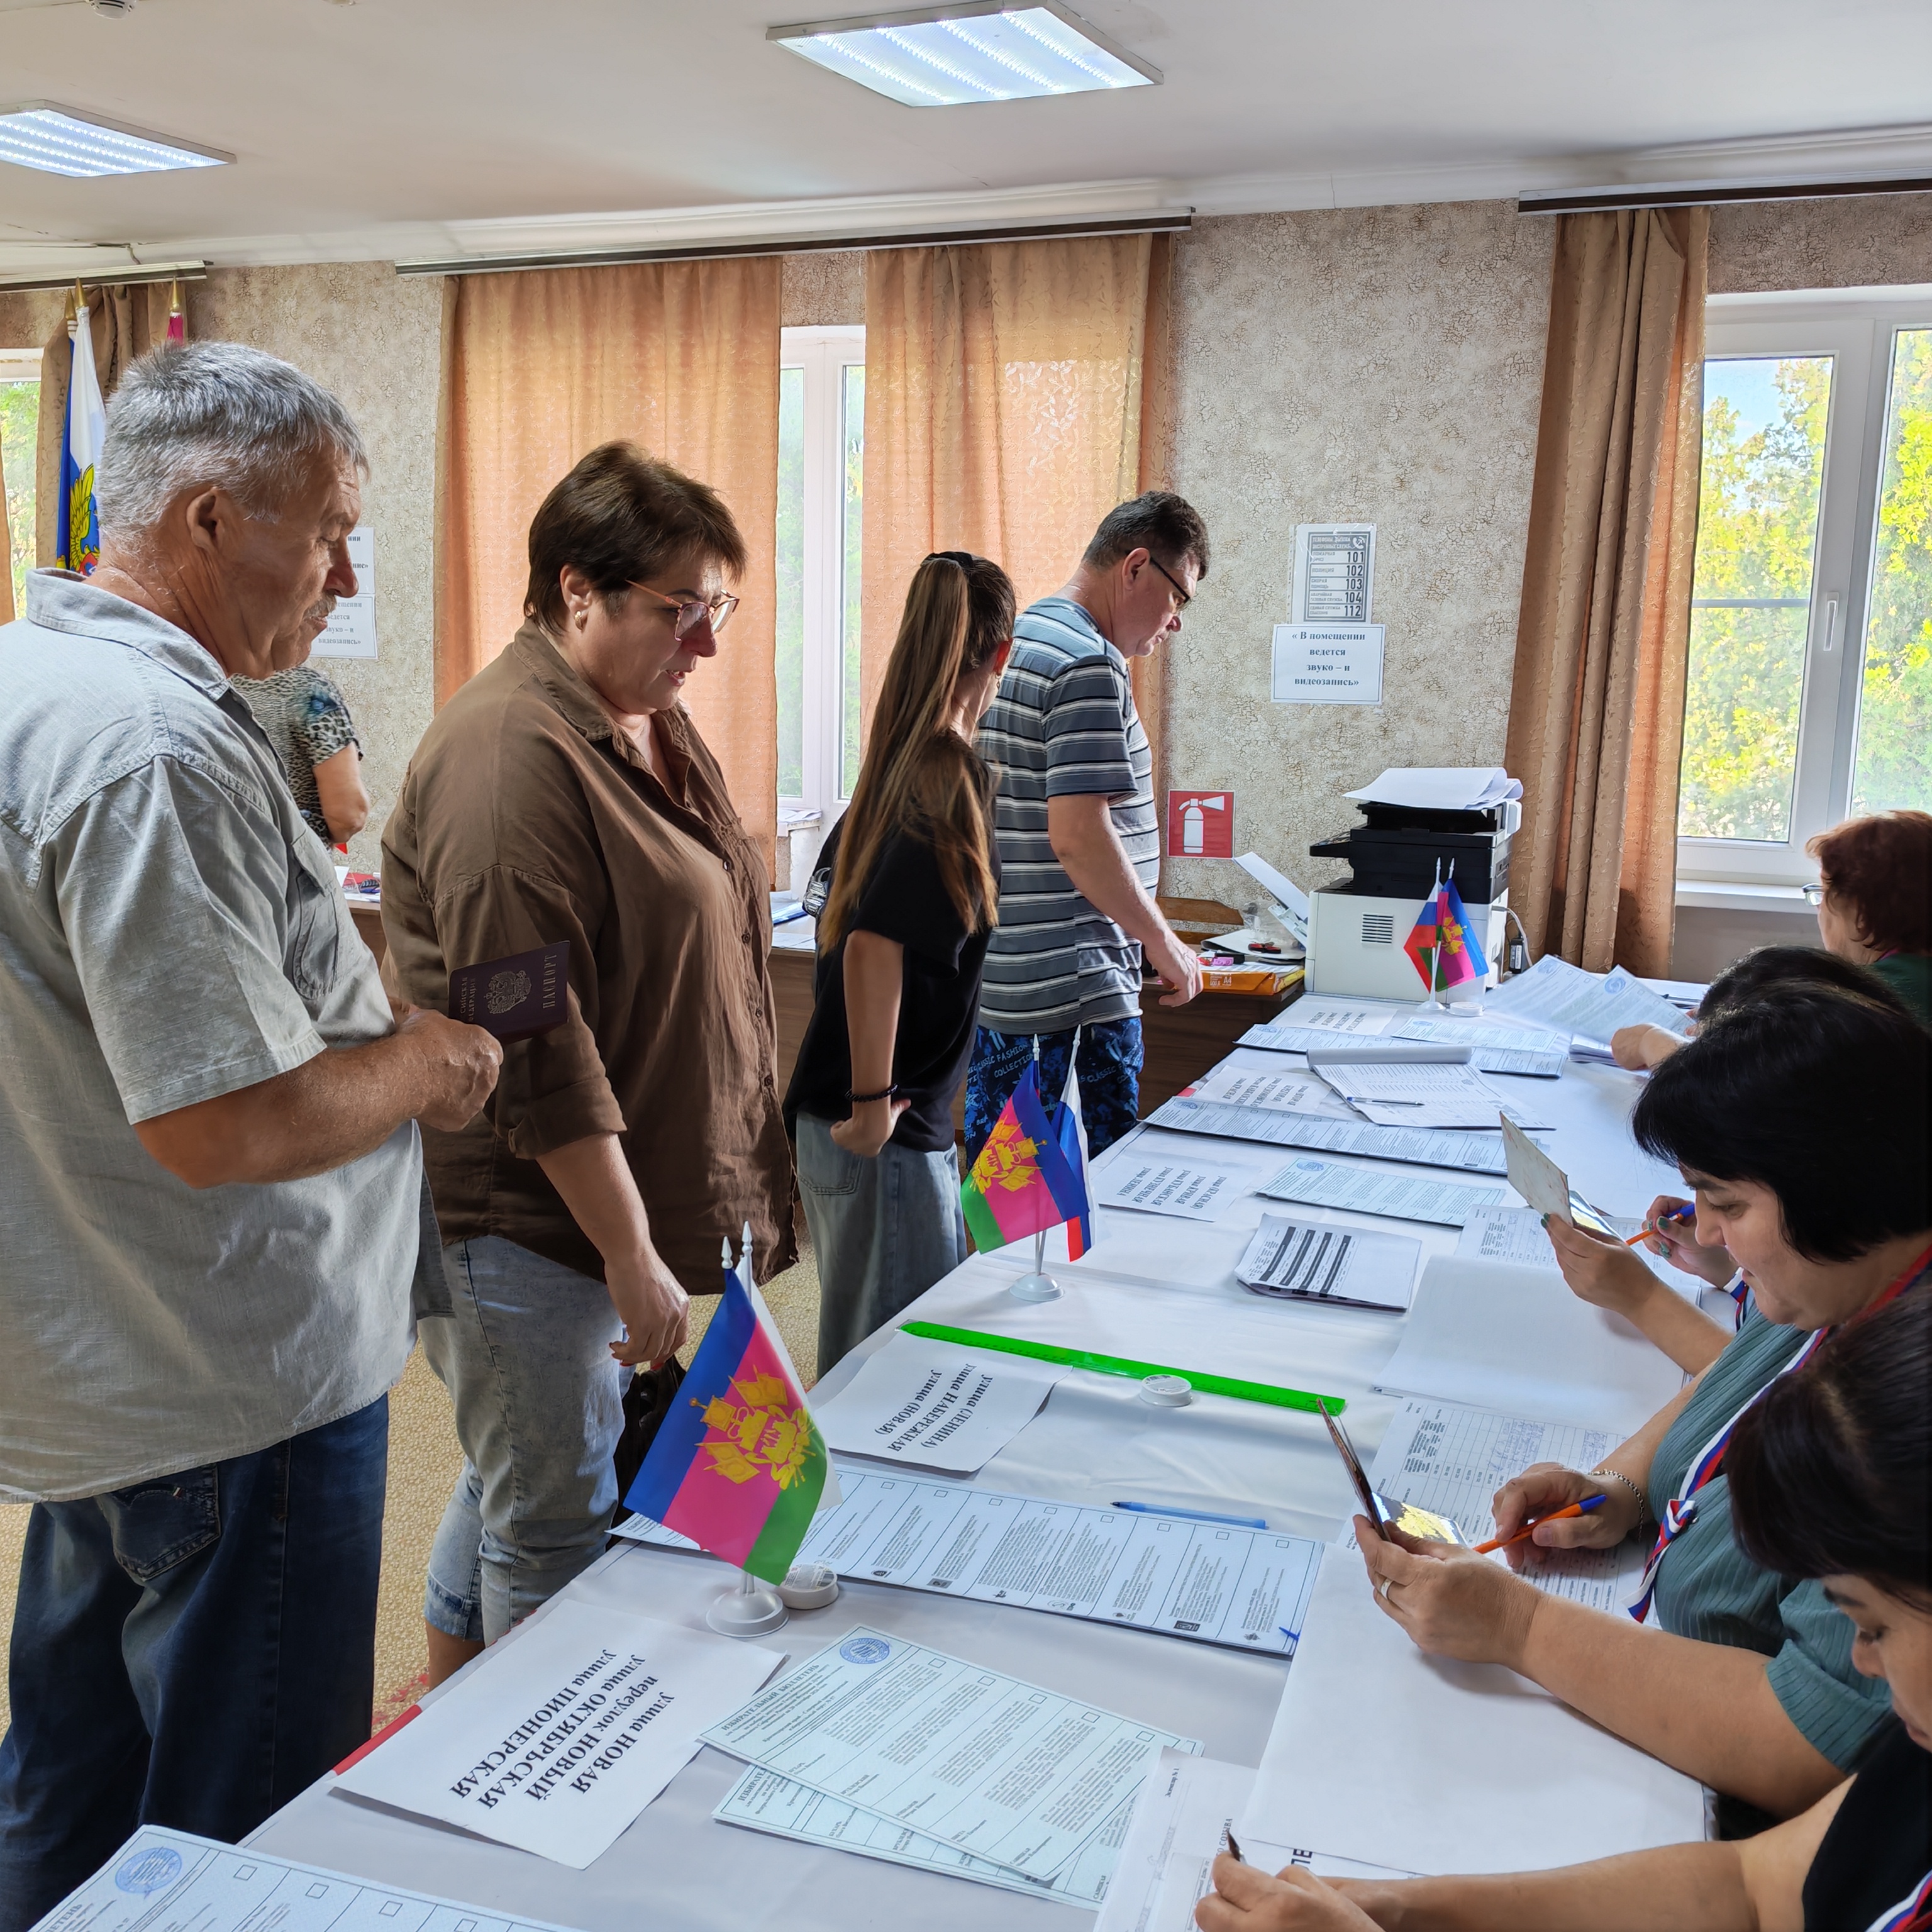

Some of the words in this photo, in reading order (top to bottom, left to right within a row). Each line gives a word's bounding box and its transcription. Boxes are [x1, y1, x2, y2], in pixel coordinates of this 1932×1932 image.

[1346, 565, 1363, 576] 102
[1347, 552, 1363, 563] 101
[1345, 592, 1362, 603] 104
[1346, 579, 1362, 590] 103
[1345, 605, 1361, 616] 112
[1309, 632, 1365, 641] помещении
[1309, 648, 1346, 657] ведется
[1294, 677, 1360, 687] видеозапись»
[1306, 663, 1334, 674] звуко
[543, 954, 557, 1009] ПАСПОРТ
[1223, 976, 1231, 984] A4
[460, 977, 468, 1014] СИЙСКАЯ
[997, 1045, 1028, 1062] FASHION
[1116, 1177, 1143, 1197] ЛЕНИНА
[1131, 1177, 1166, 1203] КУЗНЕЧНАЯ
[1150, 1179, 1184, 1206] КУБАНСКАЯ
[1175, 1186, 1199, 1205] КРИВАЯ
[1189, 1186, 1219, 1209] (КРАСНАЯ)
[914, 1369, 943, 1402] улица
[950, 1363, 977, 1391] улица
[966, 1374, 994, 1407] улица
[874, 1402, 921, 1435] (НОВАЯ)
[887, 1392, 959, 1452] НАБЕРЕЖНАЯ
[920, 1407, 974, 1448] (ЛЕНИНА)
[571, 1649, 617, 1687] улица
[601, 1654, 646, 1692] улица
[592, 1675, 659, 1732] переулок
[721, 1691, 779, 1731] ИЗБИРАТЕЛЬНЫЙ
[778, 1665, 819, 1692] БЮЛЛЕТЕНЬ
[629, 1692, 675, 1733] улица
[449, 1686, 580, 1799] ПИОНЕРСКАЯ
[475, 1693, 606, 1810] ОКТЯБРЬСКАЯ
[524, 1732, 602, 1801] НОВЫЙ
[569, 1732, 638, 1795] НОВАЯ
